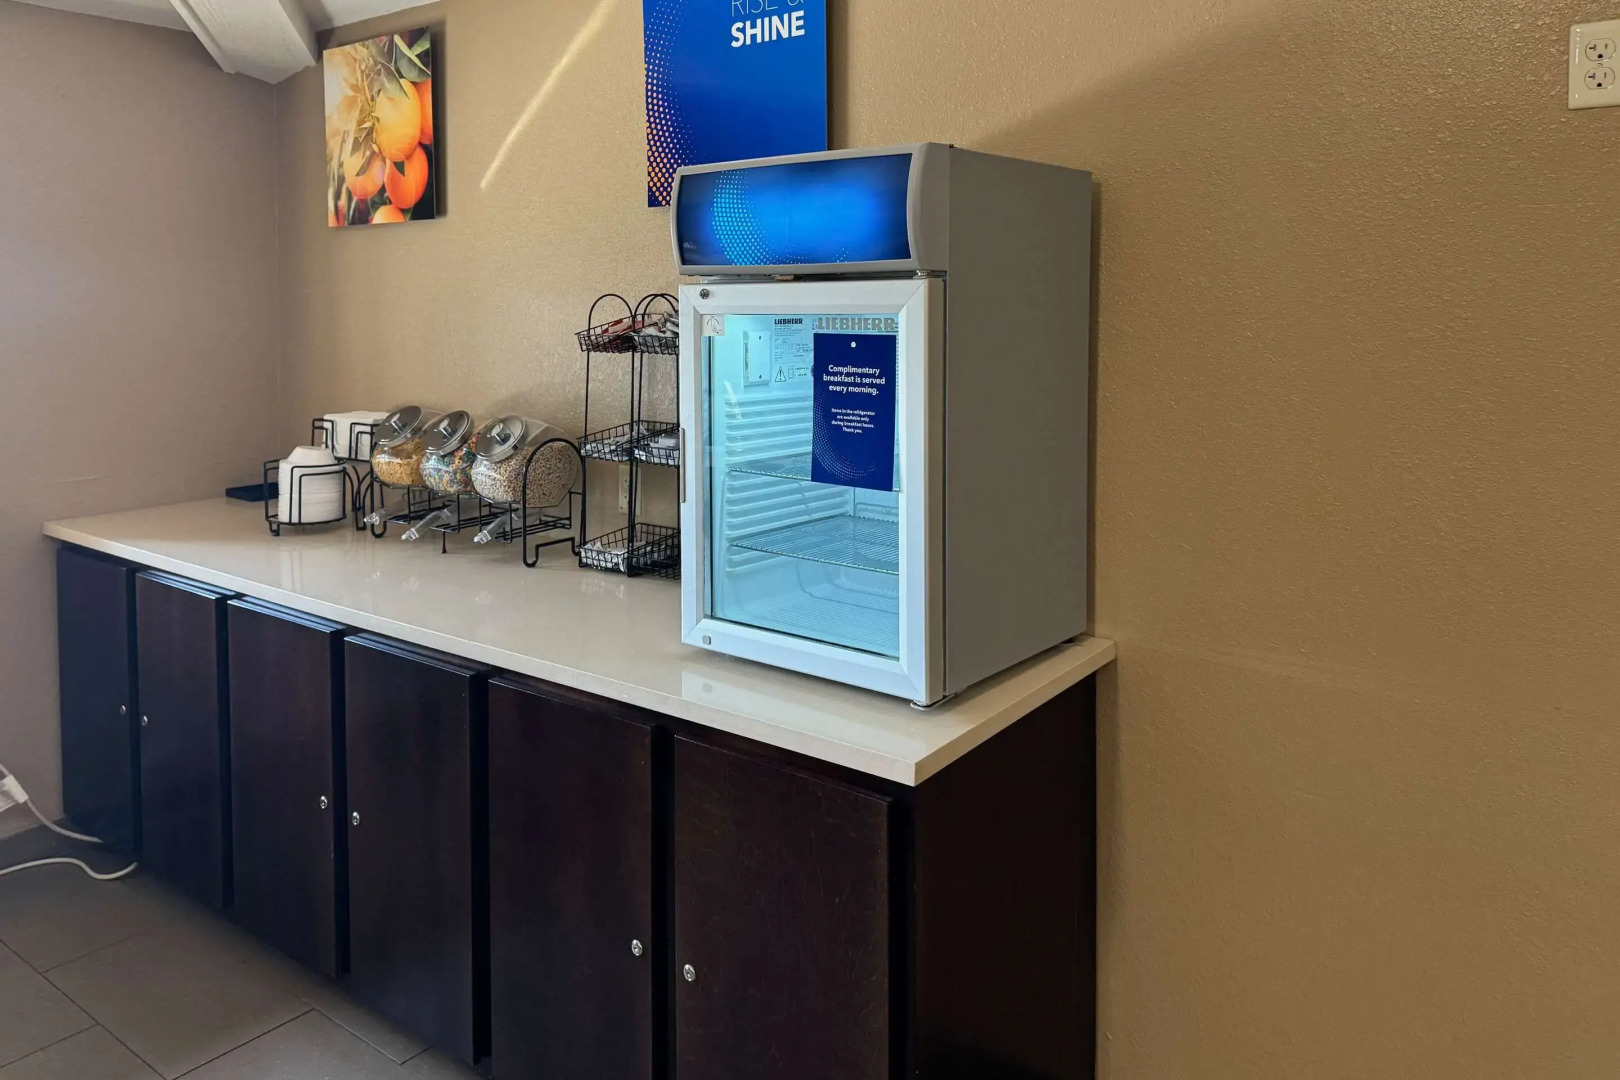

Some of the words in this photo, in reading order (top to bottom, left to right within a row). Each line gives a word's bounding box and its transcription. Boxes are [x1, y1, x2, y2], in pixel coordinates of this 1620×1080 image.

[731, 10, 805, 48] SHINE
[817, 317, 896, 331] LIEBHERR
[828, 364, 880, 376] Complimentary
[823, 373, 855, 383] breakfast
[855, 375, 861, 383] is
[862, 377, 886, 385] served
[828, 385, 847, 394] every
[848, 386, 879, 396] morning.
